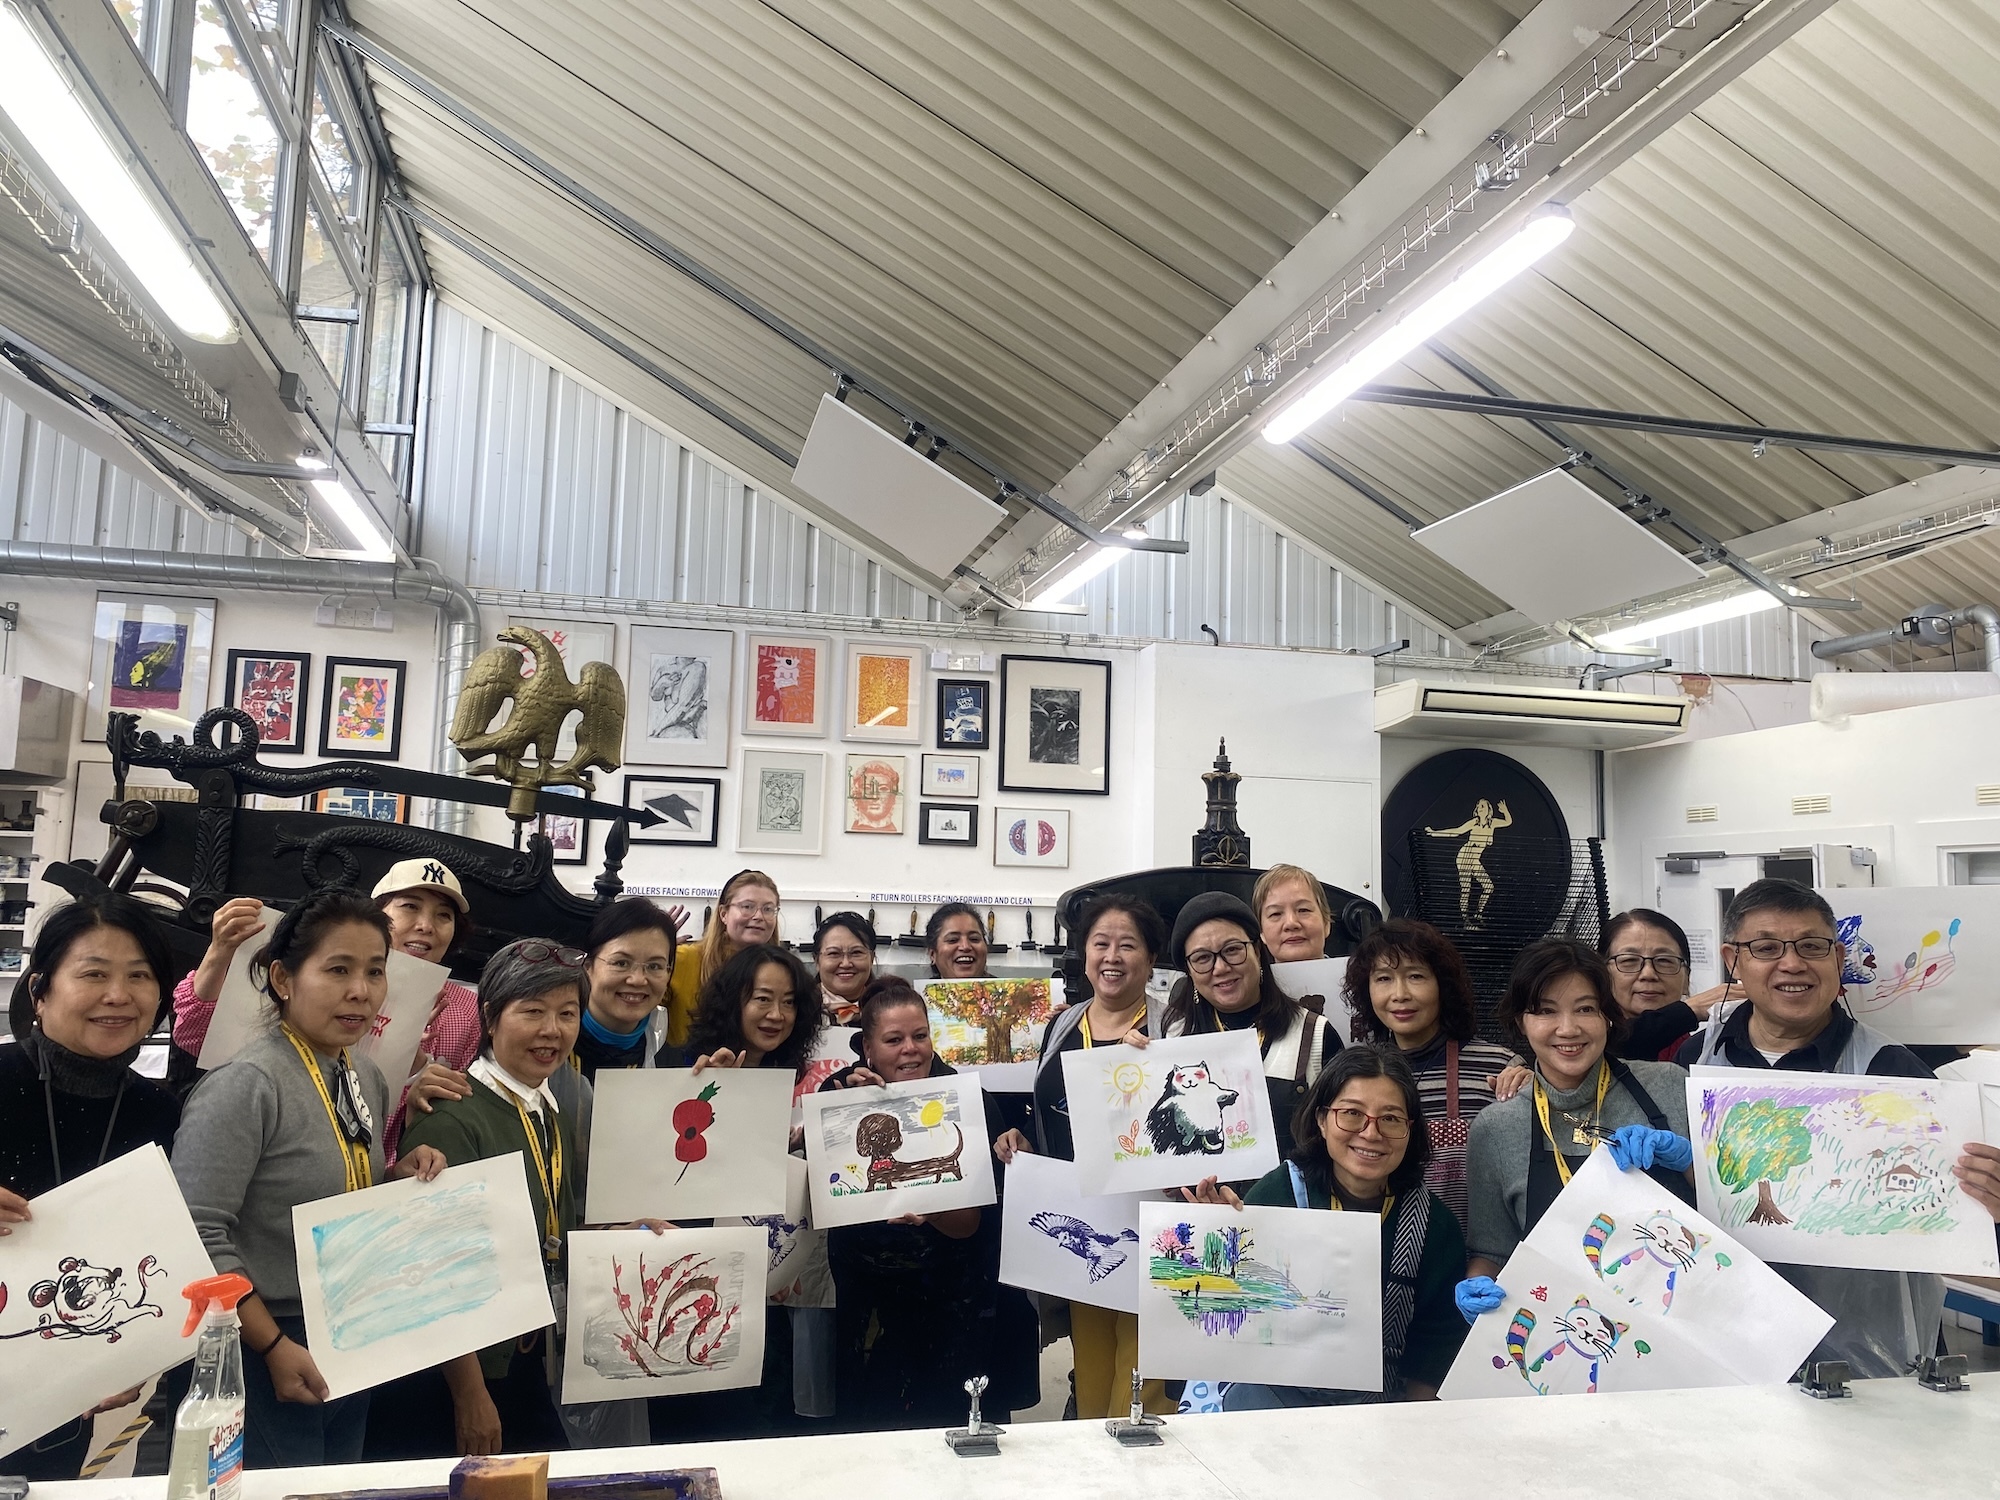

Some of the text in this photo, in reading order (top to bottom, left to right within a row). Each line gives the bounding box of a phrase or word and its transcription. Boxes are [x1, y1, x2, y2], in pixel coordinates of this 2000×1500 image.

[422, 863, 445, 884] NY
[626, 886, 661, 896] ROLLERS
[662, 887, 690, 896] FACING
[691, 888, 723, 898] FORWAR
[870, 893, 1033, 905] RETURN ROLLERS FACING FORWARD AND CLEAN
